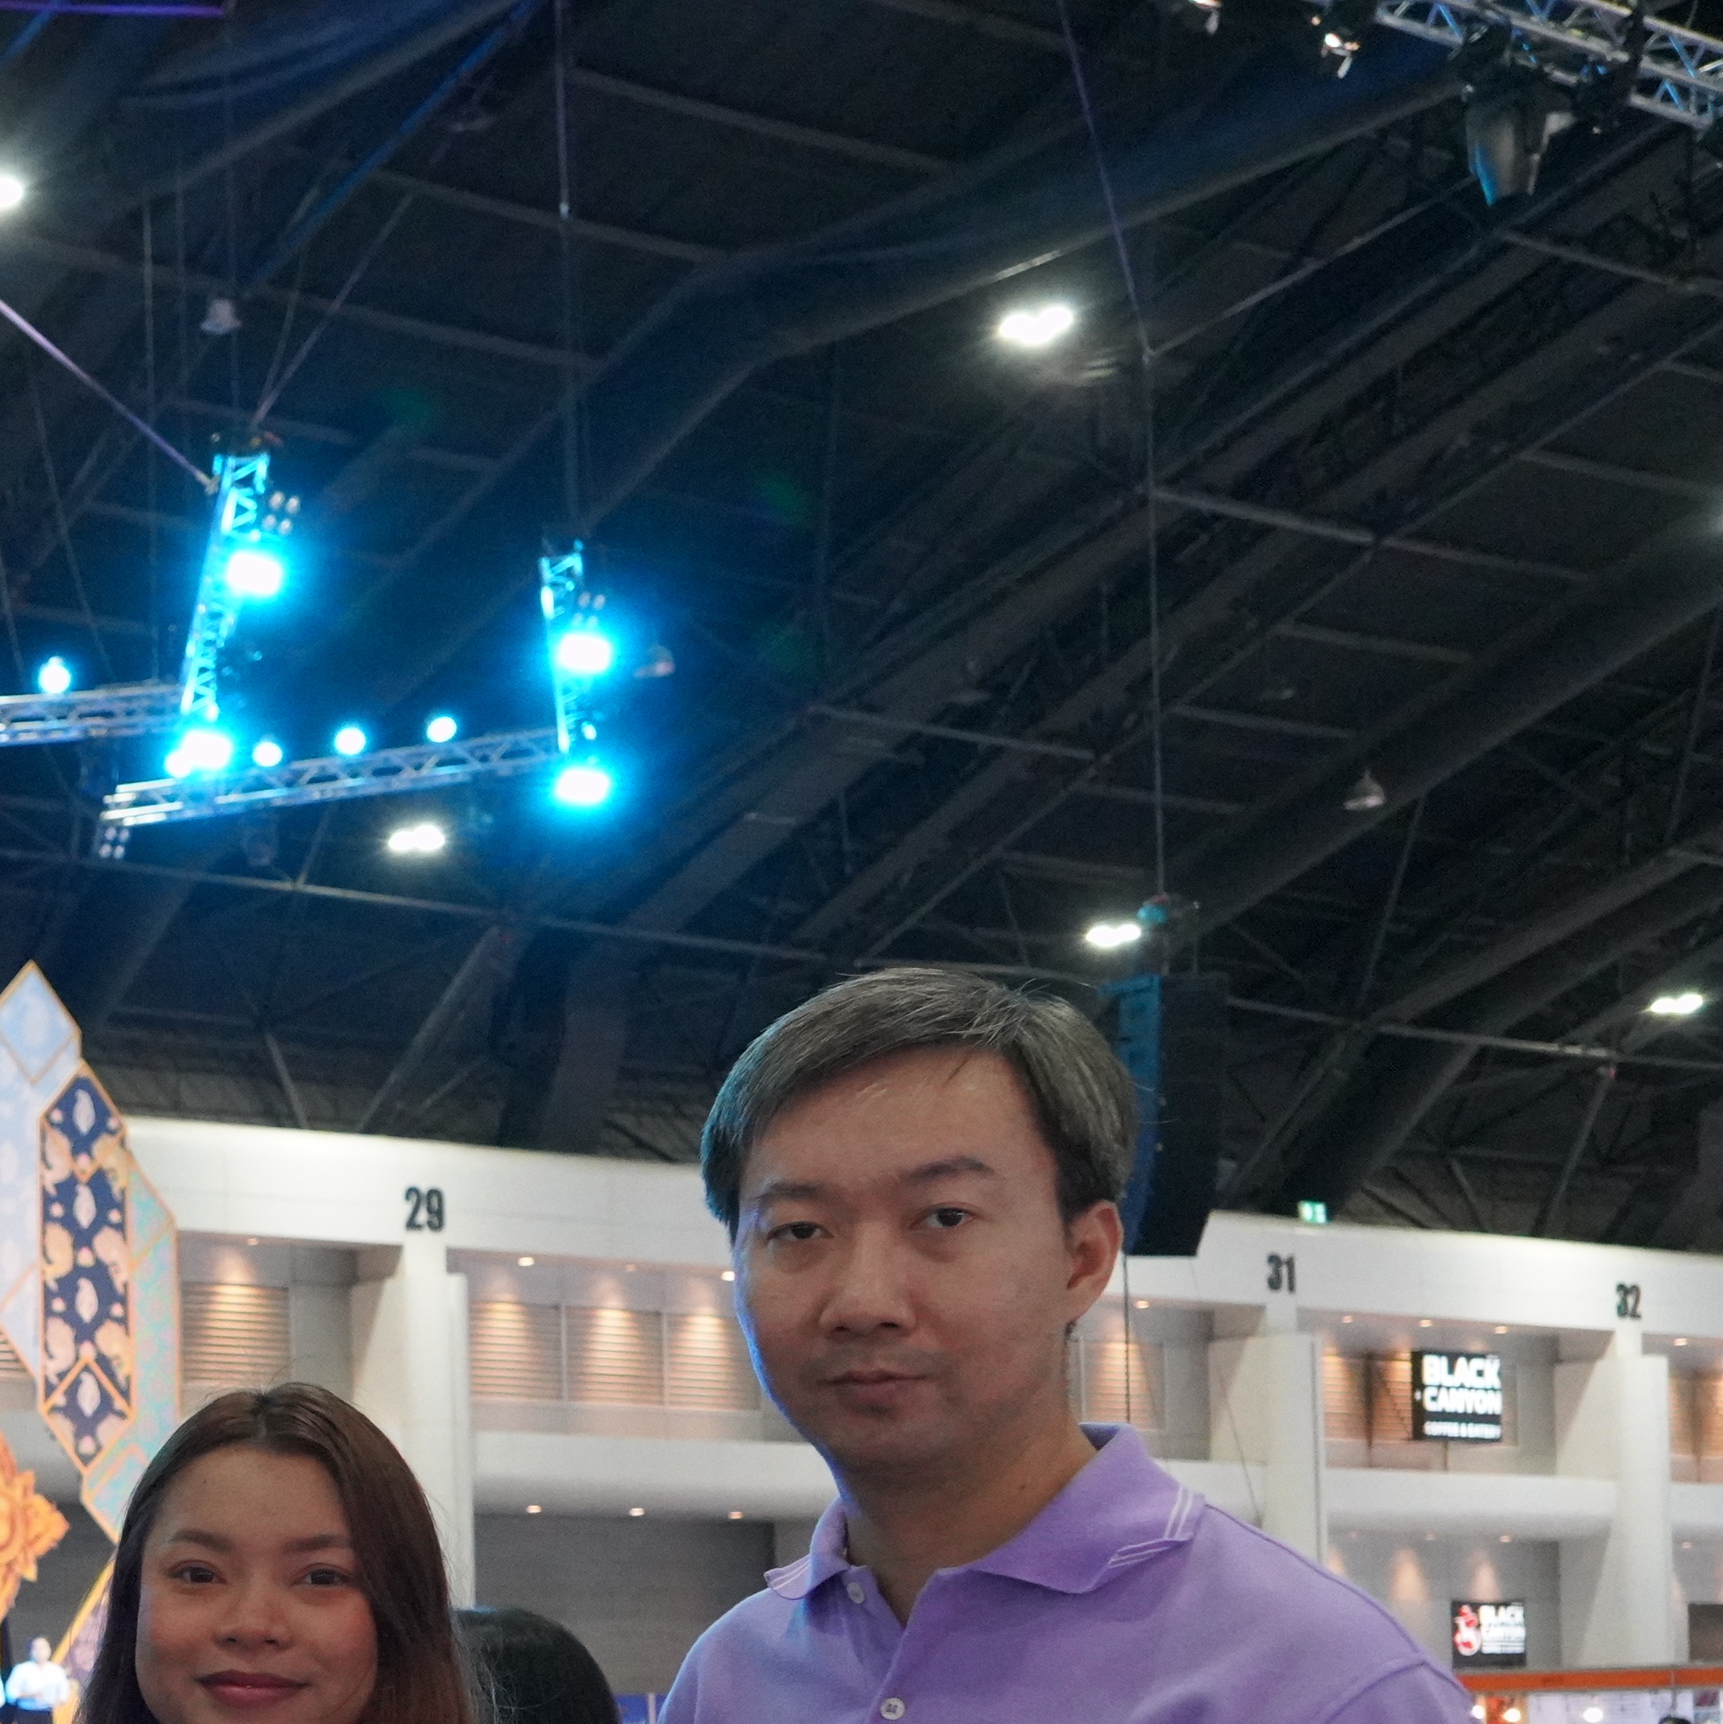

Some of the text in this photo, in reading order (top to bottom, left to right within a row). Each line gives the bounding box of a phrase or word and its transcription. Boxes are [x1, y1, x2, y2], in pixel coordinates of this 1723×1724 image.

[405, 1187, 445, 1232] 29
[1266, 1254, 1296, 1293] 31
[1616, 1283, 1642, 1319] 32
[1422, 1354, 1502, 1389] BLACK
[1423, 1386, 1503, 1415] CANYON
